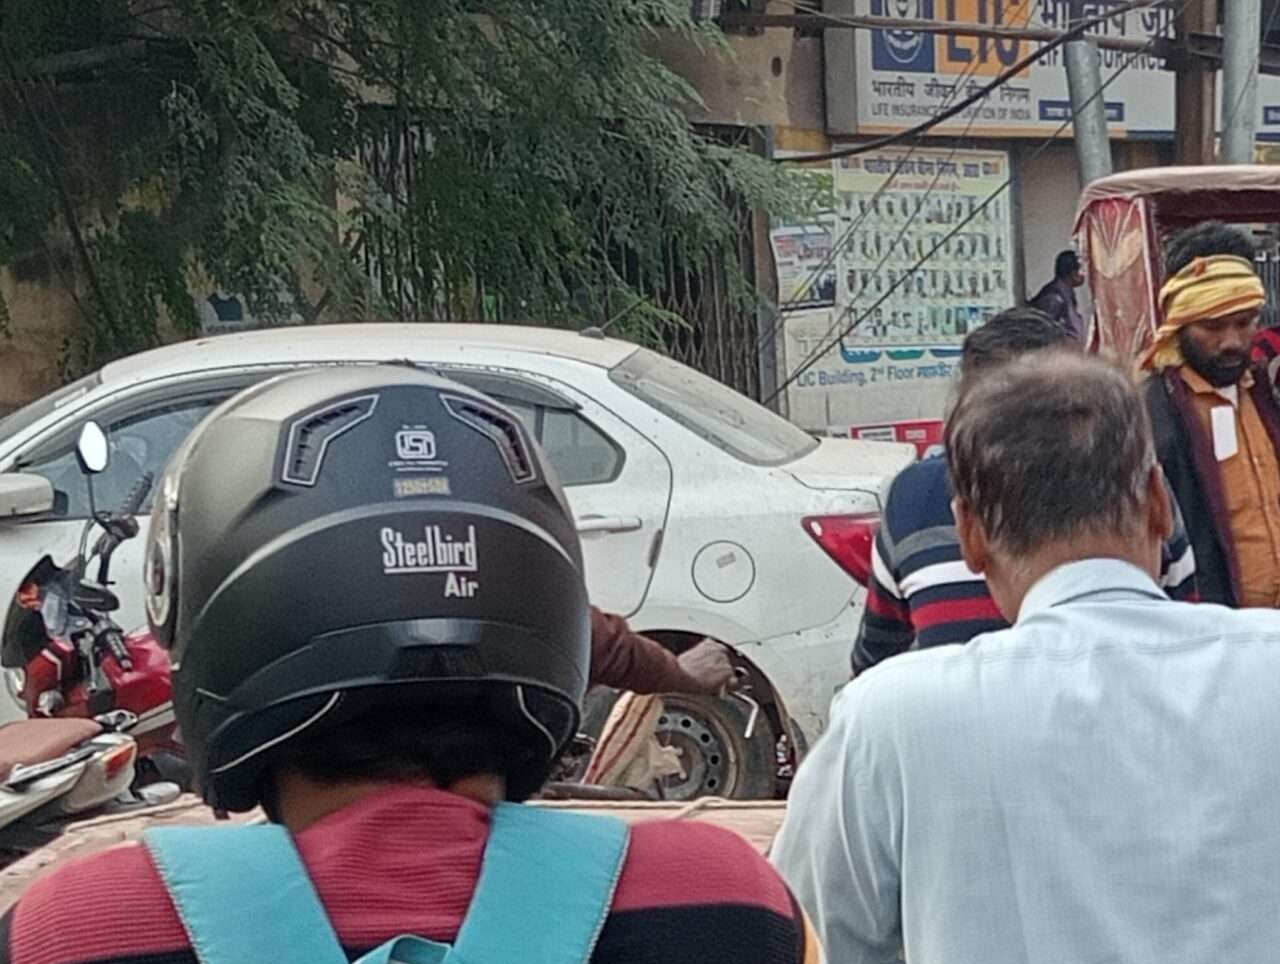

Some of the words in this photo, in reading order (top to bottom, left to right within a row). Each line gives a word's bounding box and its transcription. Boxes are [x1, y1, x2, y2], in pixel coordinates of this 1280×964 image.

[947, 0, 1021, 66] LIC
[871, 75, 914, 97] भारतीय
[924, 78, 957, 98] जीवन
[797, 371, 816, 387] LIC
[818, 369, 867, 387] Building,
[887, 365, 914, 380] Floor
[380, 524, 478, 571] Steelbird
[444, 572, 479, 597] Air
